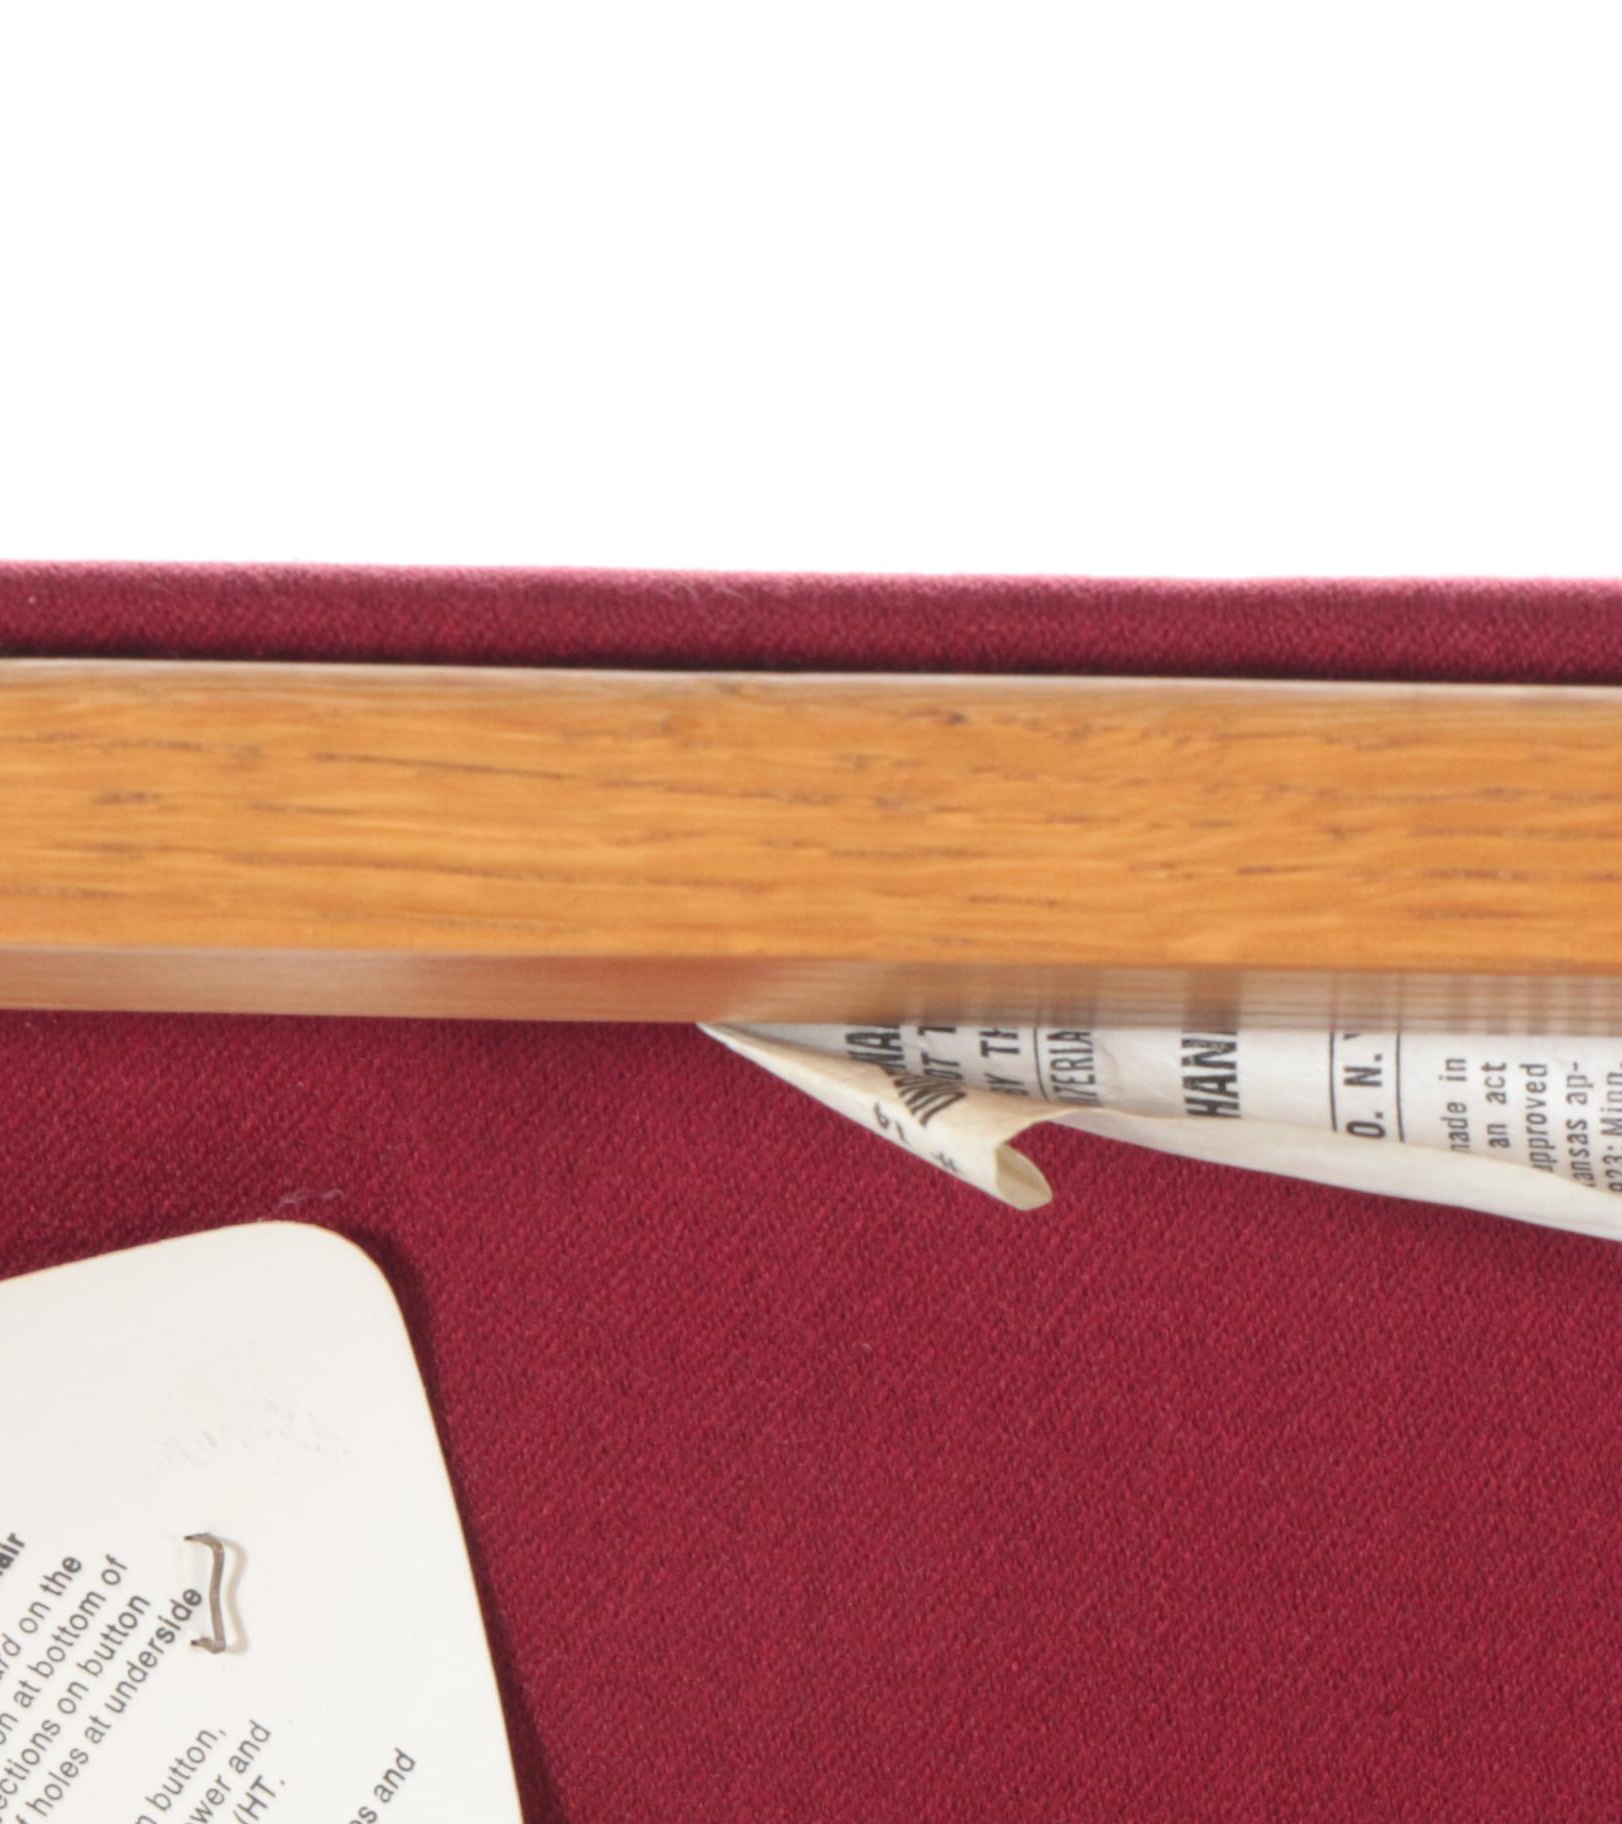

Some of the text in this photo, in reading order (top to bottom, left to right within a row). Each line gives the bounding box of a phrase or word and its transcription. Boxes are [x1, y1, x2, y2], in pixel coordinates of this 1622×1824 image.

[1046, 1028, 1101, 1106] TERIA
[1181, 1030, 1242, 1119] HAN
[1438, 1056, 1467, 1082] in
[1480, 1060, 1511, 1149] an act
[17, 1600, 51, 1634] on
[38, 1555, 82, 1597] the
[99, 1553, 128, 1586] of
[26, 1590, 106, 1679] bottom
[56, 1680, 89, 1715] on
[75, 1594, 151, 1677] button
[12, 1679, 41, 1709] at
[24, 1747, 89, 1817] holes
[83, 1714, 111, 1745] at
[103, 1587, 203, 1714] underside
[144, 1729, 225, 1812] button,
[227, 1718, 271, 1775] and
[372, 1746, 416, 1804] and
